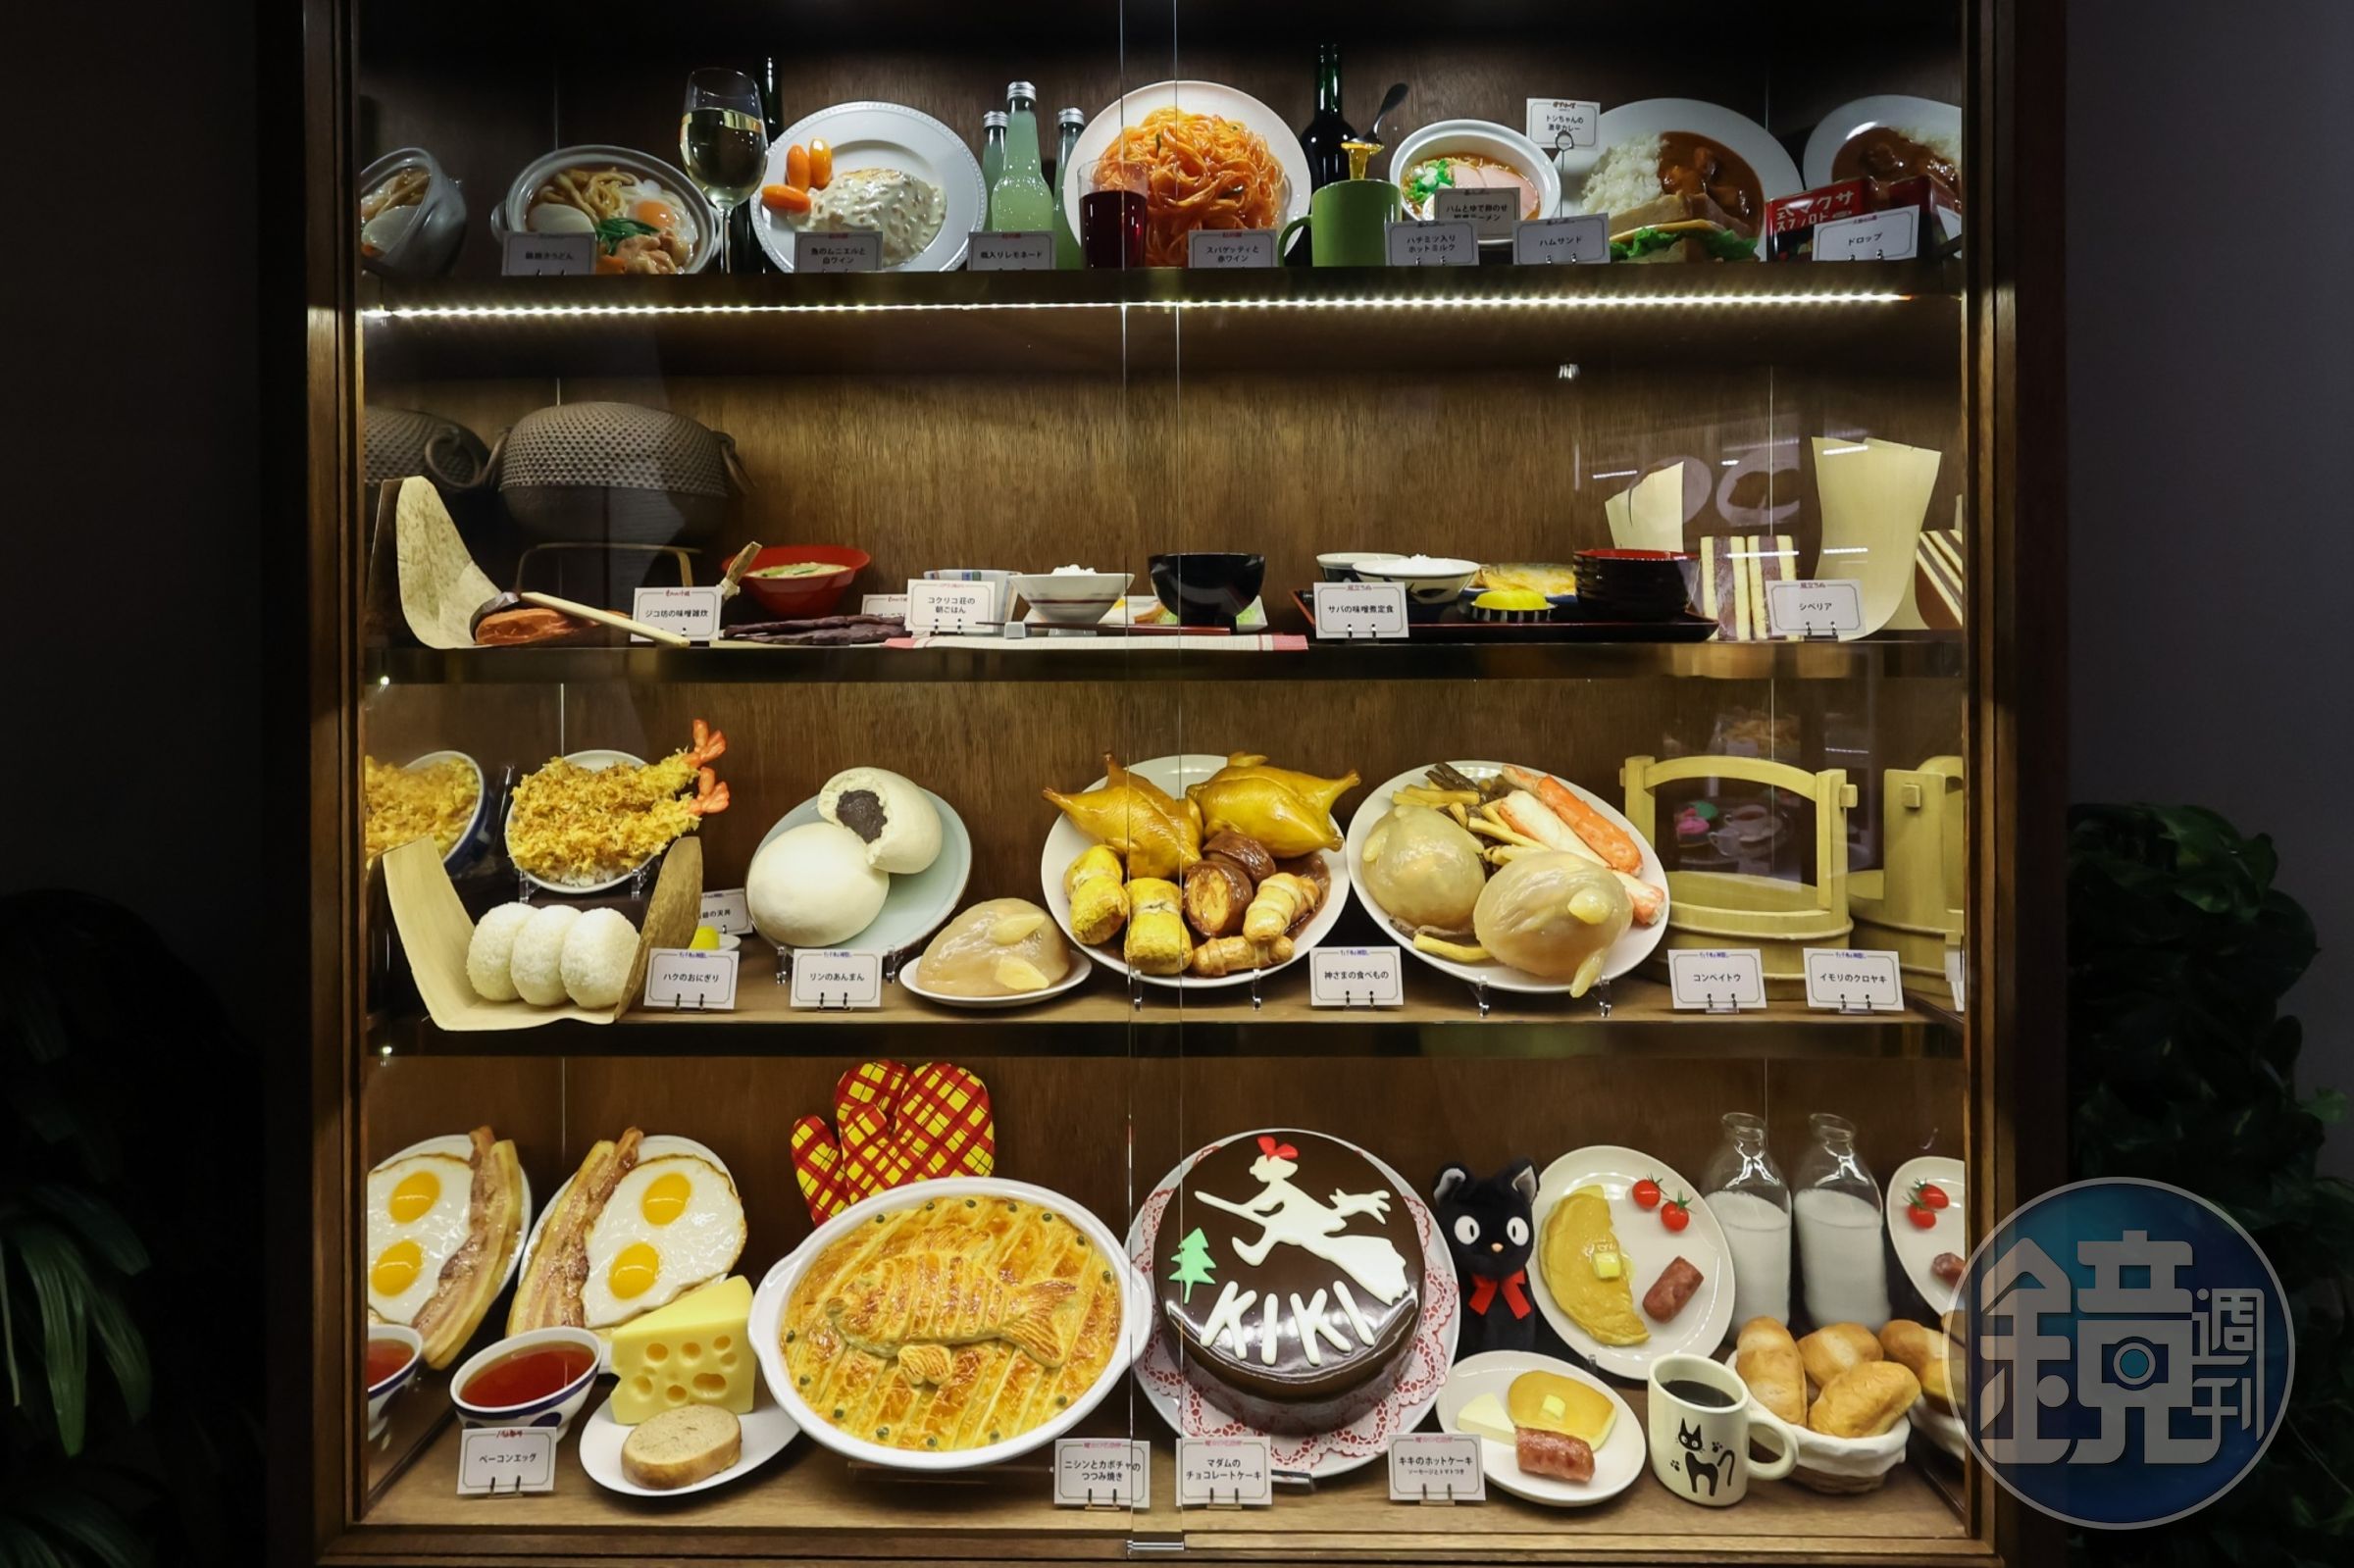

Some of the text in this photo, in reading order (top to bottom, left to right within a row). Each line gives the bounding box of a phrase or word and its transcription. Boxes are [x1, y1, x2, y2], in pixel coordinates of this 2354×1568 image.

[1407, 234, 1457, 245] ハチミツ入り
[1539, 235, 1583, 247] ハムサンド
[1848, 231, 1883, 246] ドロップ
[928, 596, 976, 605] コクリコ荘の
[1798, 601, 1832, 611] シベリア
[645, 609, 709, 619] ジコ坊の味噌雑炊
[935, 605, 966, 614] 朝ごはん
[1328, 604, 1395, 615] サバの味噌煮定食
[663, 972, 721, 984] ハクのおにぎり
[809, 972, 866, 983] リンのあんまん
[1324, 970, 1390, 981] 神さまの食べもの
[1819, 973, 1887, 985] イモリのクロヤキ
[1199, 1280, 1375, 1367] KIKI
[479, 1452, 537, 1464] ベーコンエッグ
[1207, 1457, 1242, 1469] マダムの
[1398, 1455, 1473, 1467] キキのホットケーキ
[1064, 1459, 1142, 1473] ニシンとカボチャの
[1081, 1471, 1123, 1483] つつみ焼き
[1185, 1470, 1262, 1481] チョコレートケーキ
